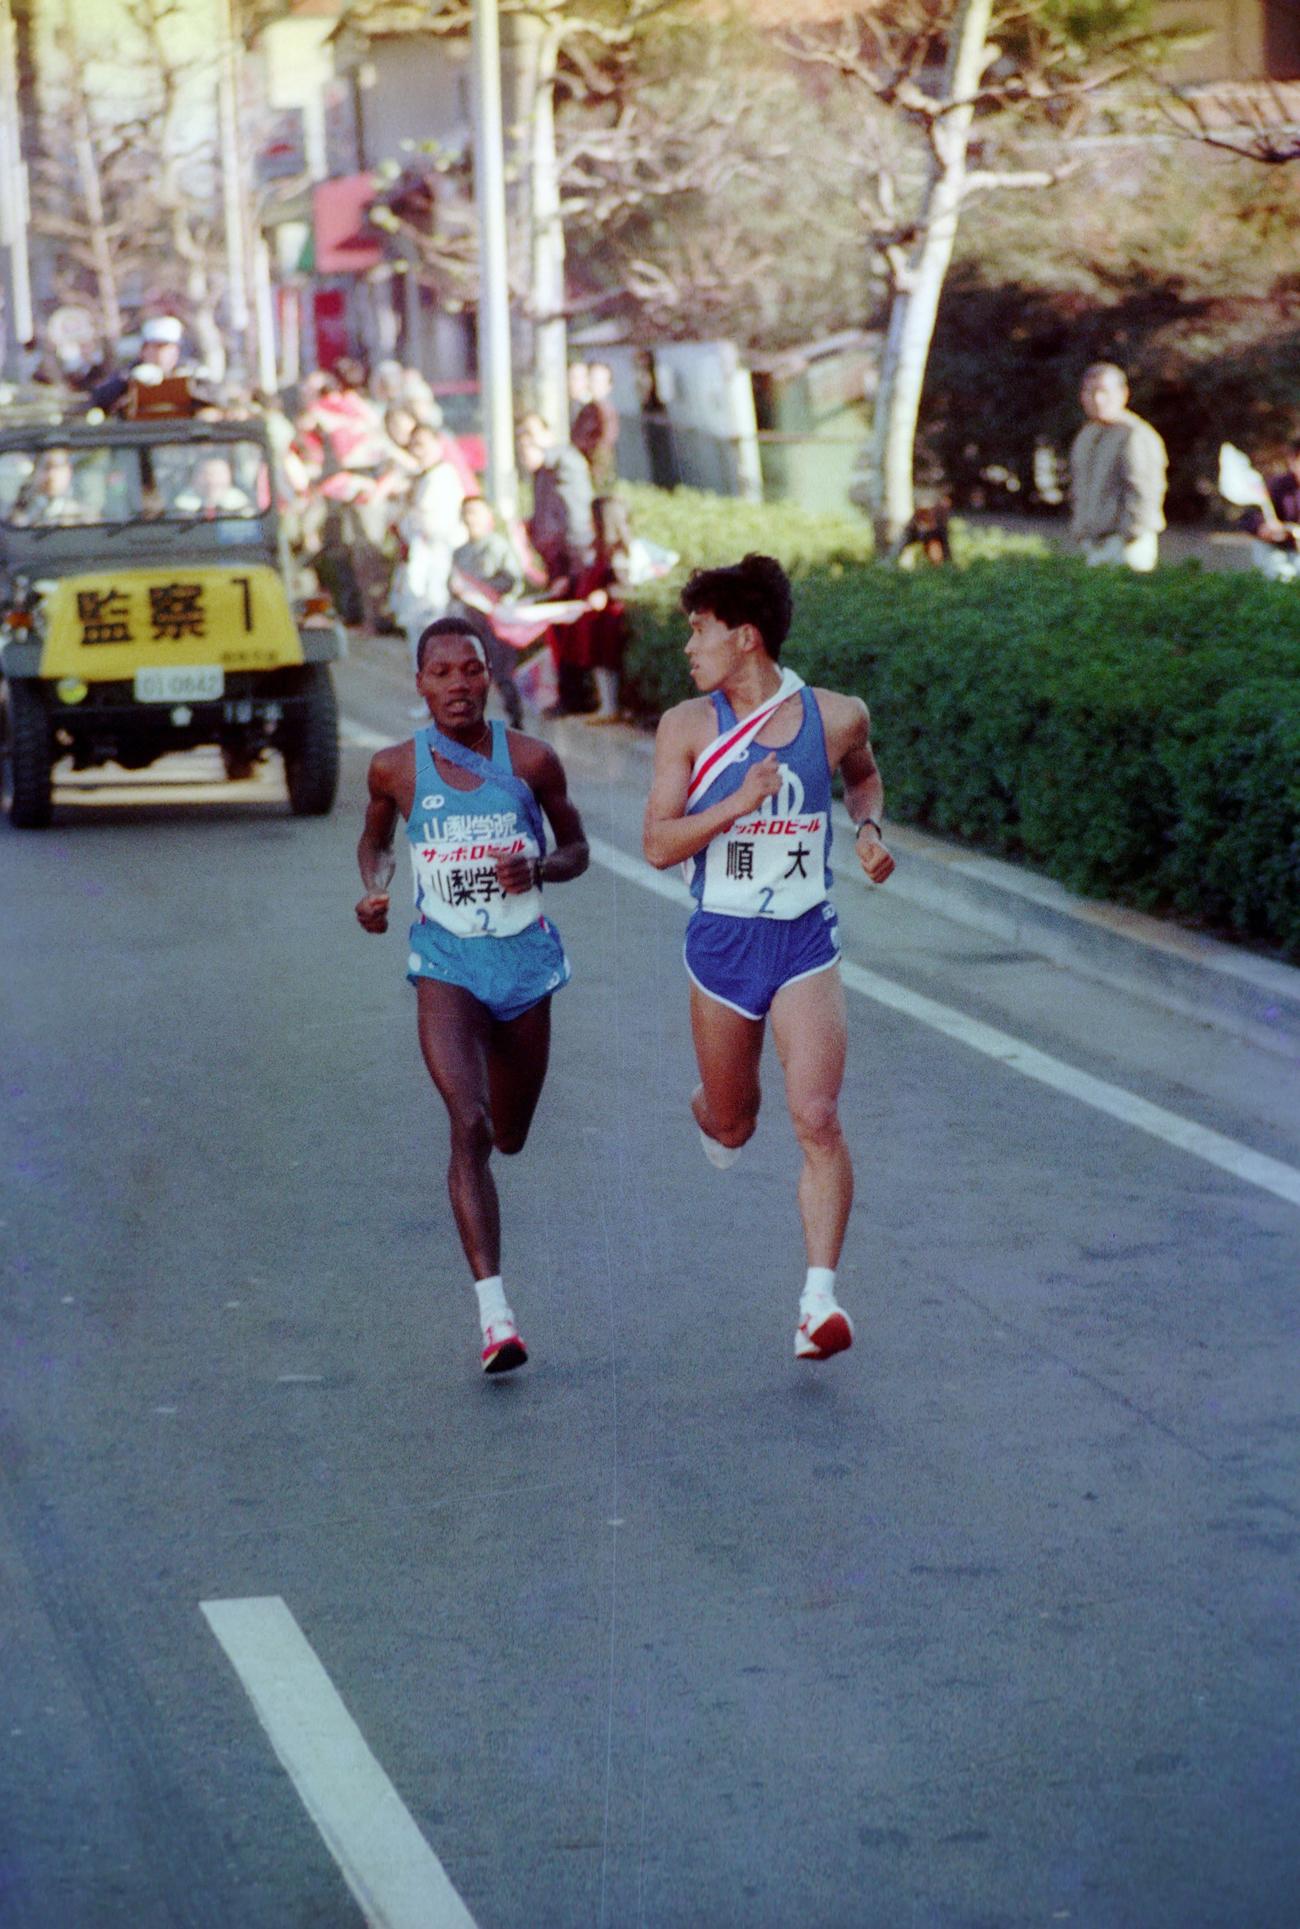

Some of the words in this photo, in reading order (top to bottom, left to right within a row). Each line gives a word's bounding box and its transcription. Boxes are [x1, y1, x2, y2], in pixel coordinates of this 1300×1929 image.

[422, 811, 518, 842] 山梨学院
[723, 818, 821, 835] ッポロビール
[726, 841, 811, 881] 順大
[431, 867, 507, 907] 山梨学
[758, 886, 775, 915] 2
[475, 908, 498, 933] 2
